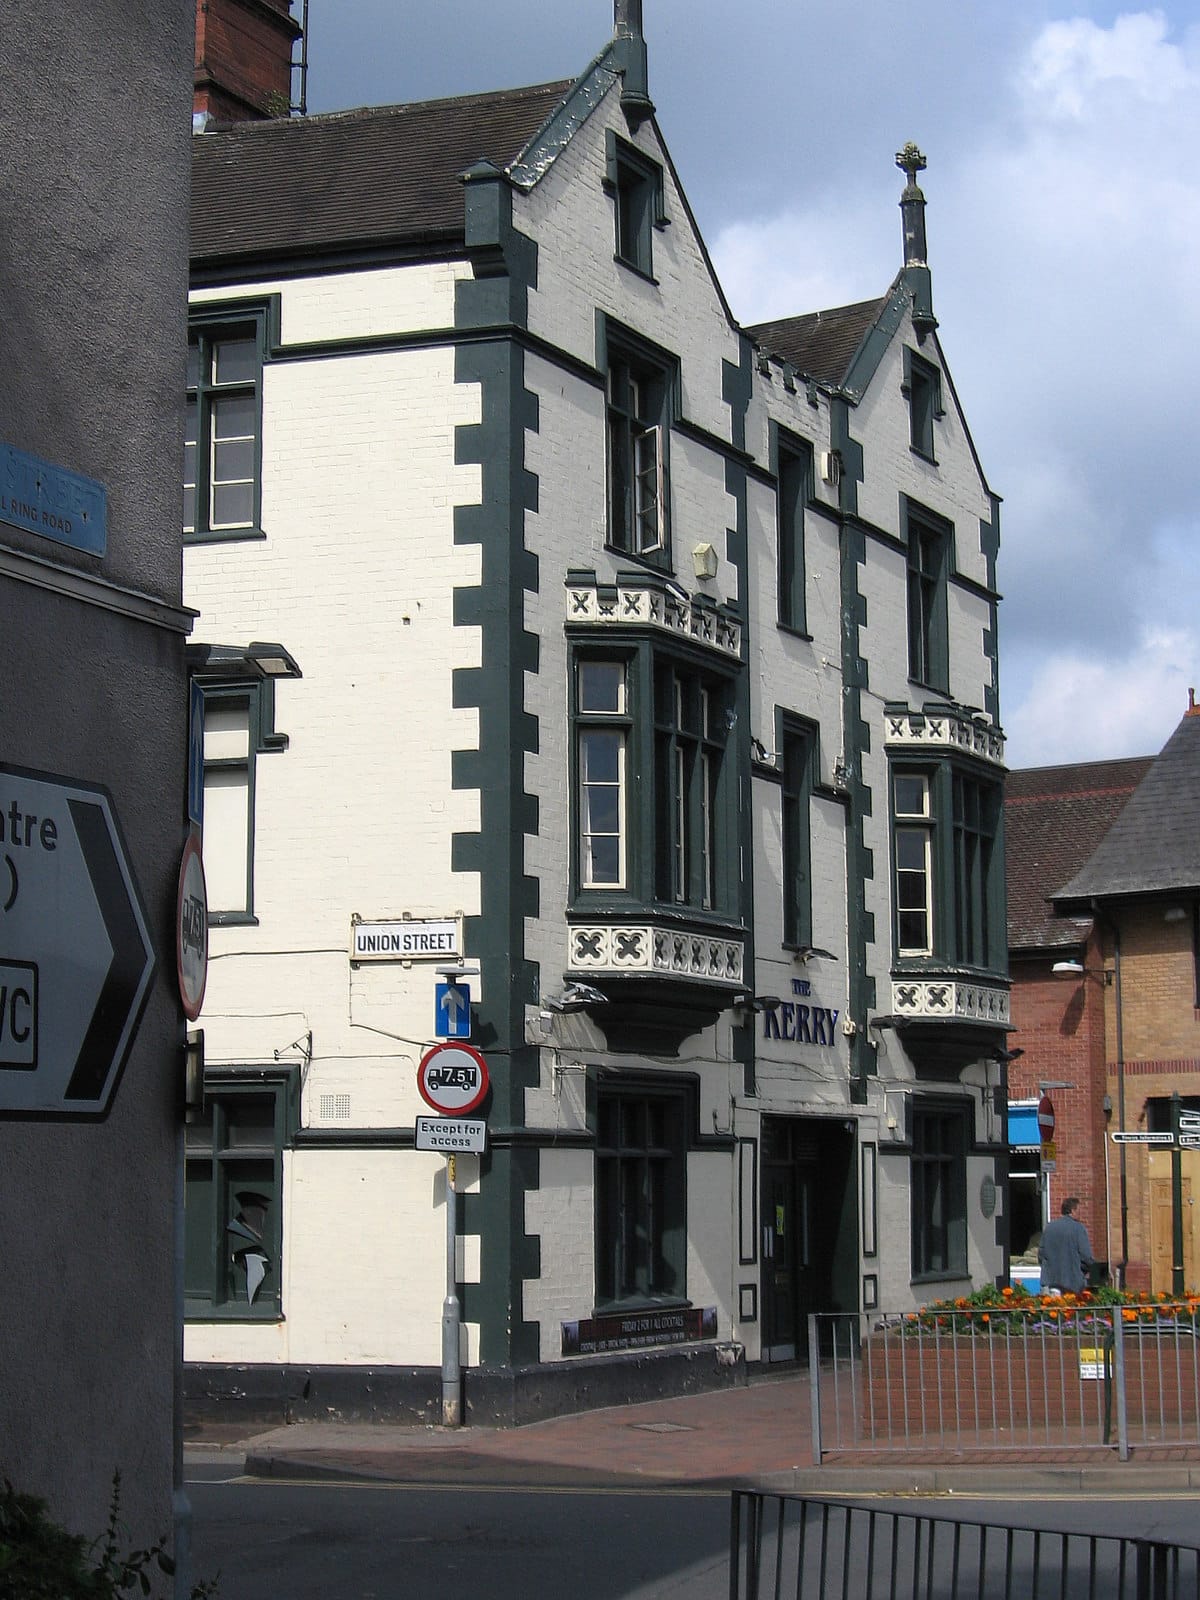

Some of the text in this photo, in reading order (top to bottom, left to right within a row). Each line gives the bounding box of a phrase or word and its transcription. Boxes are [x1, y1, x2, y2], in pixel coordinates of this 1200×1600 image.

[11, 499, 38, 521] RING
[42, 511, 72, 534] ROAD
[358, 933, 455, 952] UNION STREET
[791, 978, 811, 997] THE
[0, 985, 30, 1044] C
[764, 1001, 840, 1047] KERRY
[442, 1067, 476, 1083] 7.5T
[421, 1122, 481, 1135] Except for
[430, 1137, 471, 1147] access
